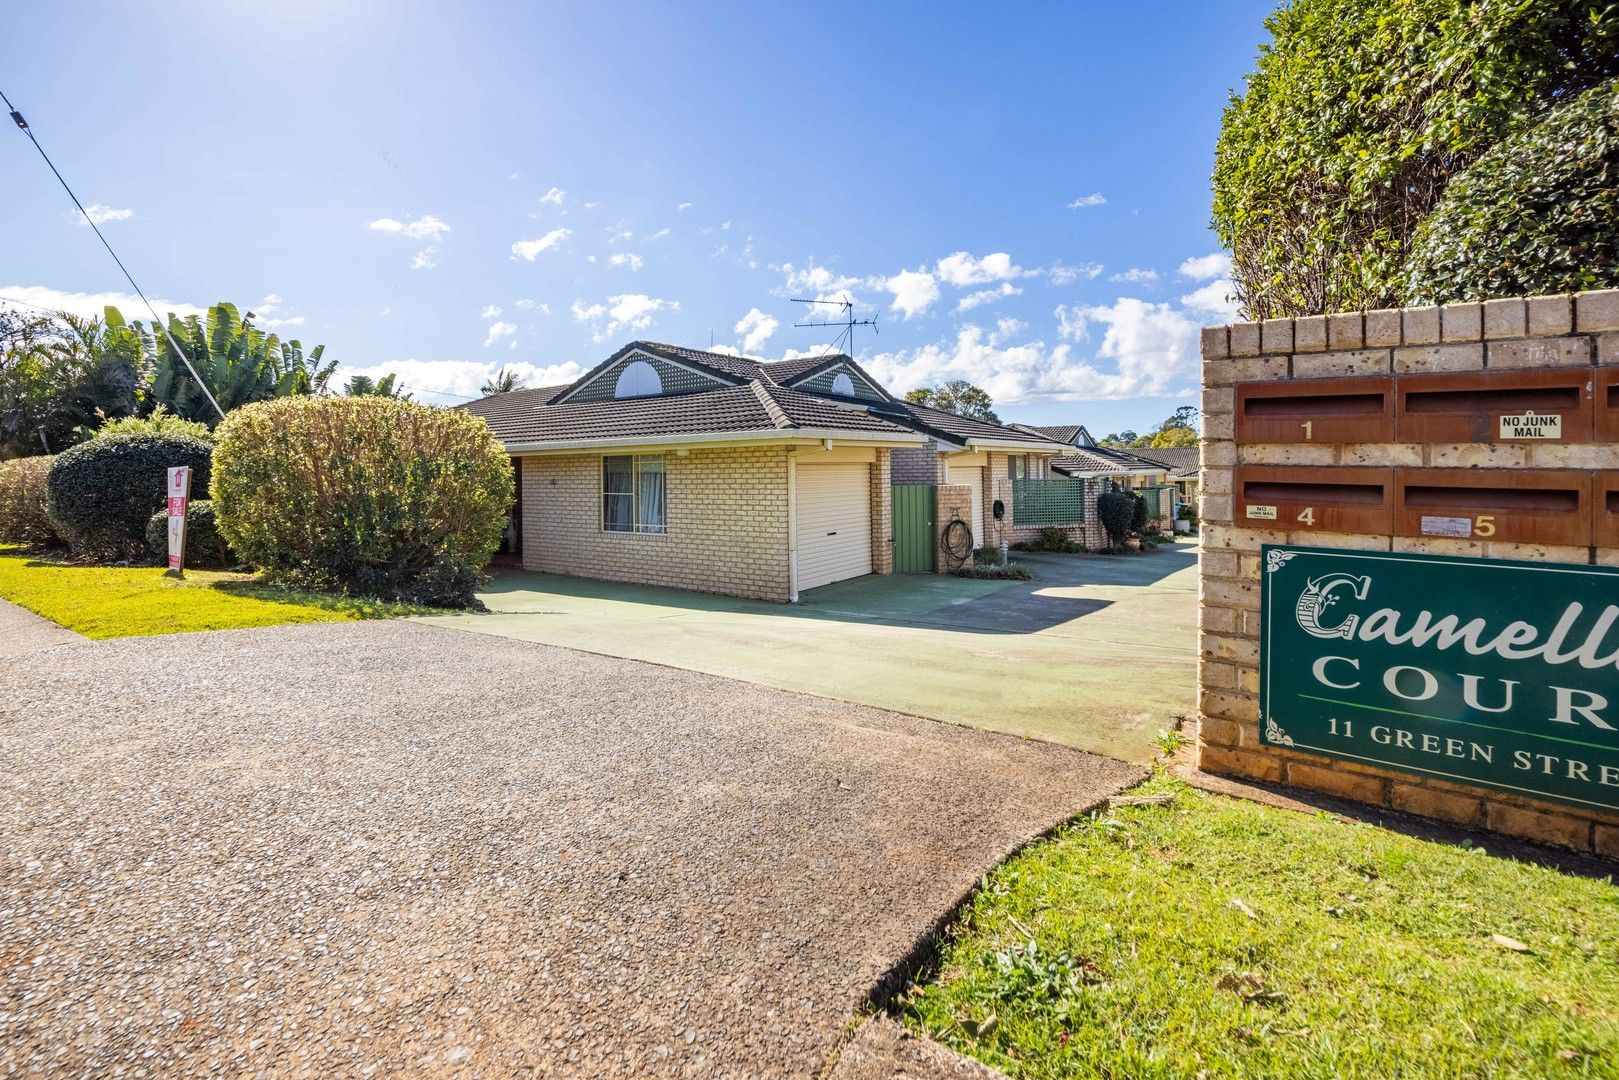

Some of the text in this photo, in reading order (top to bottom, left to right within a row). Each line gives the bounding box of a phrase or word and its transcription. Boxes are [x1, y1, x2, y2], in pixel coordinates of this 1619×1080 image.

[1300, 421, 1313, 440] 1
[1468, 411, 1491, 443] 2
[1503, 416, 1557, 427] NO JUNK
[1514, 427, 1545, 437] MAIL
[1297, 506, 1316, 526] 4
[1473, 515, 1496, 537] 5
[1295, 572, 1619, 670] Camell
[1312, 655, 1618, 731] COUR
[1328, 718, 1354, 738] 11
[1370, 725, 1494, 764] GREEN
